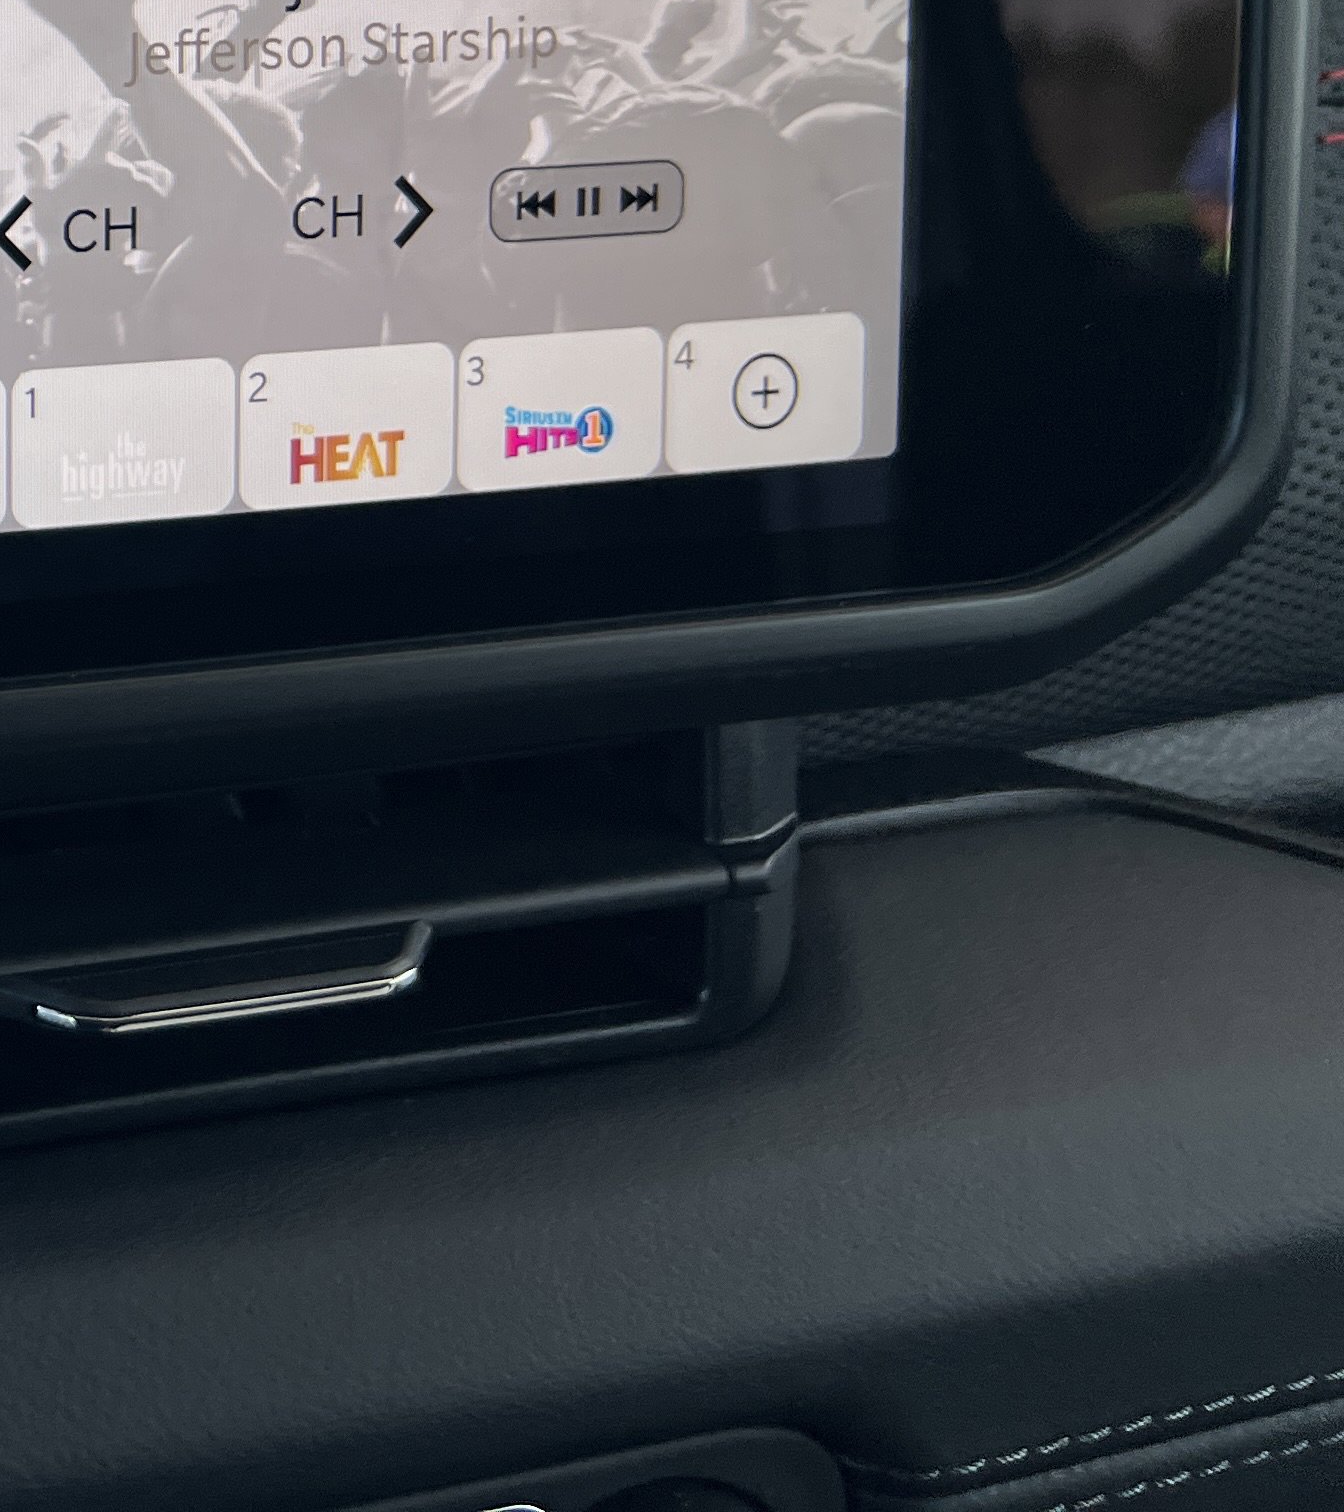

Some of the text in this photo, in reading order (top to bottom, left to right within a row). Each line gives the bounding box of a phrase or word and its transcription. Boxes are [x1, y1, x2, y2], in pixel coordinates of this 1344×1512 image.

[123, 16, 559, 89] Jefferson Starship
[63, 206, 139, 254] CH
[292, 194, 365, 240] CH
[466, 356, 486, 386] 3
[673, 340, 695, 370] 4
[24, 387, 38, 419] 1
[248, 372, 269, 404] 2
[62, 451, 185, 500] highway
[290, 430, 405, 485] HEAT
